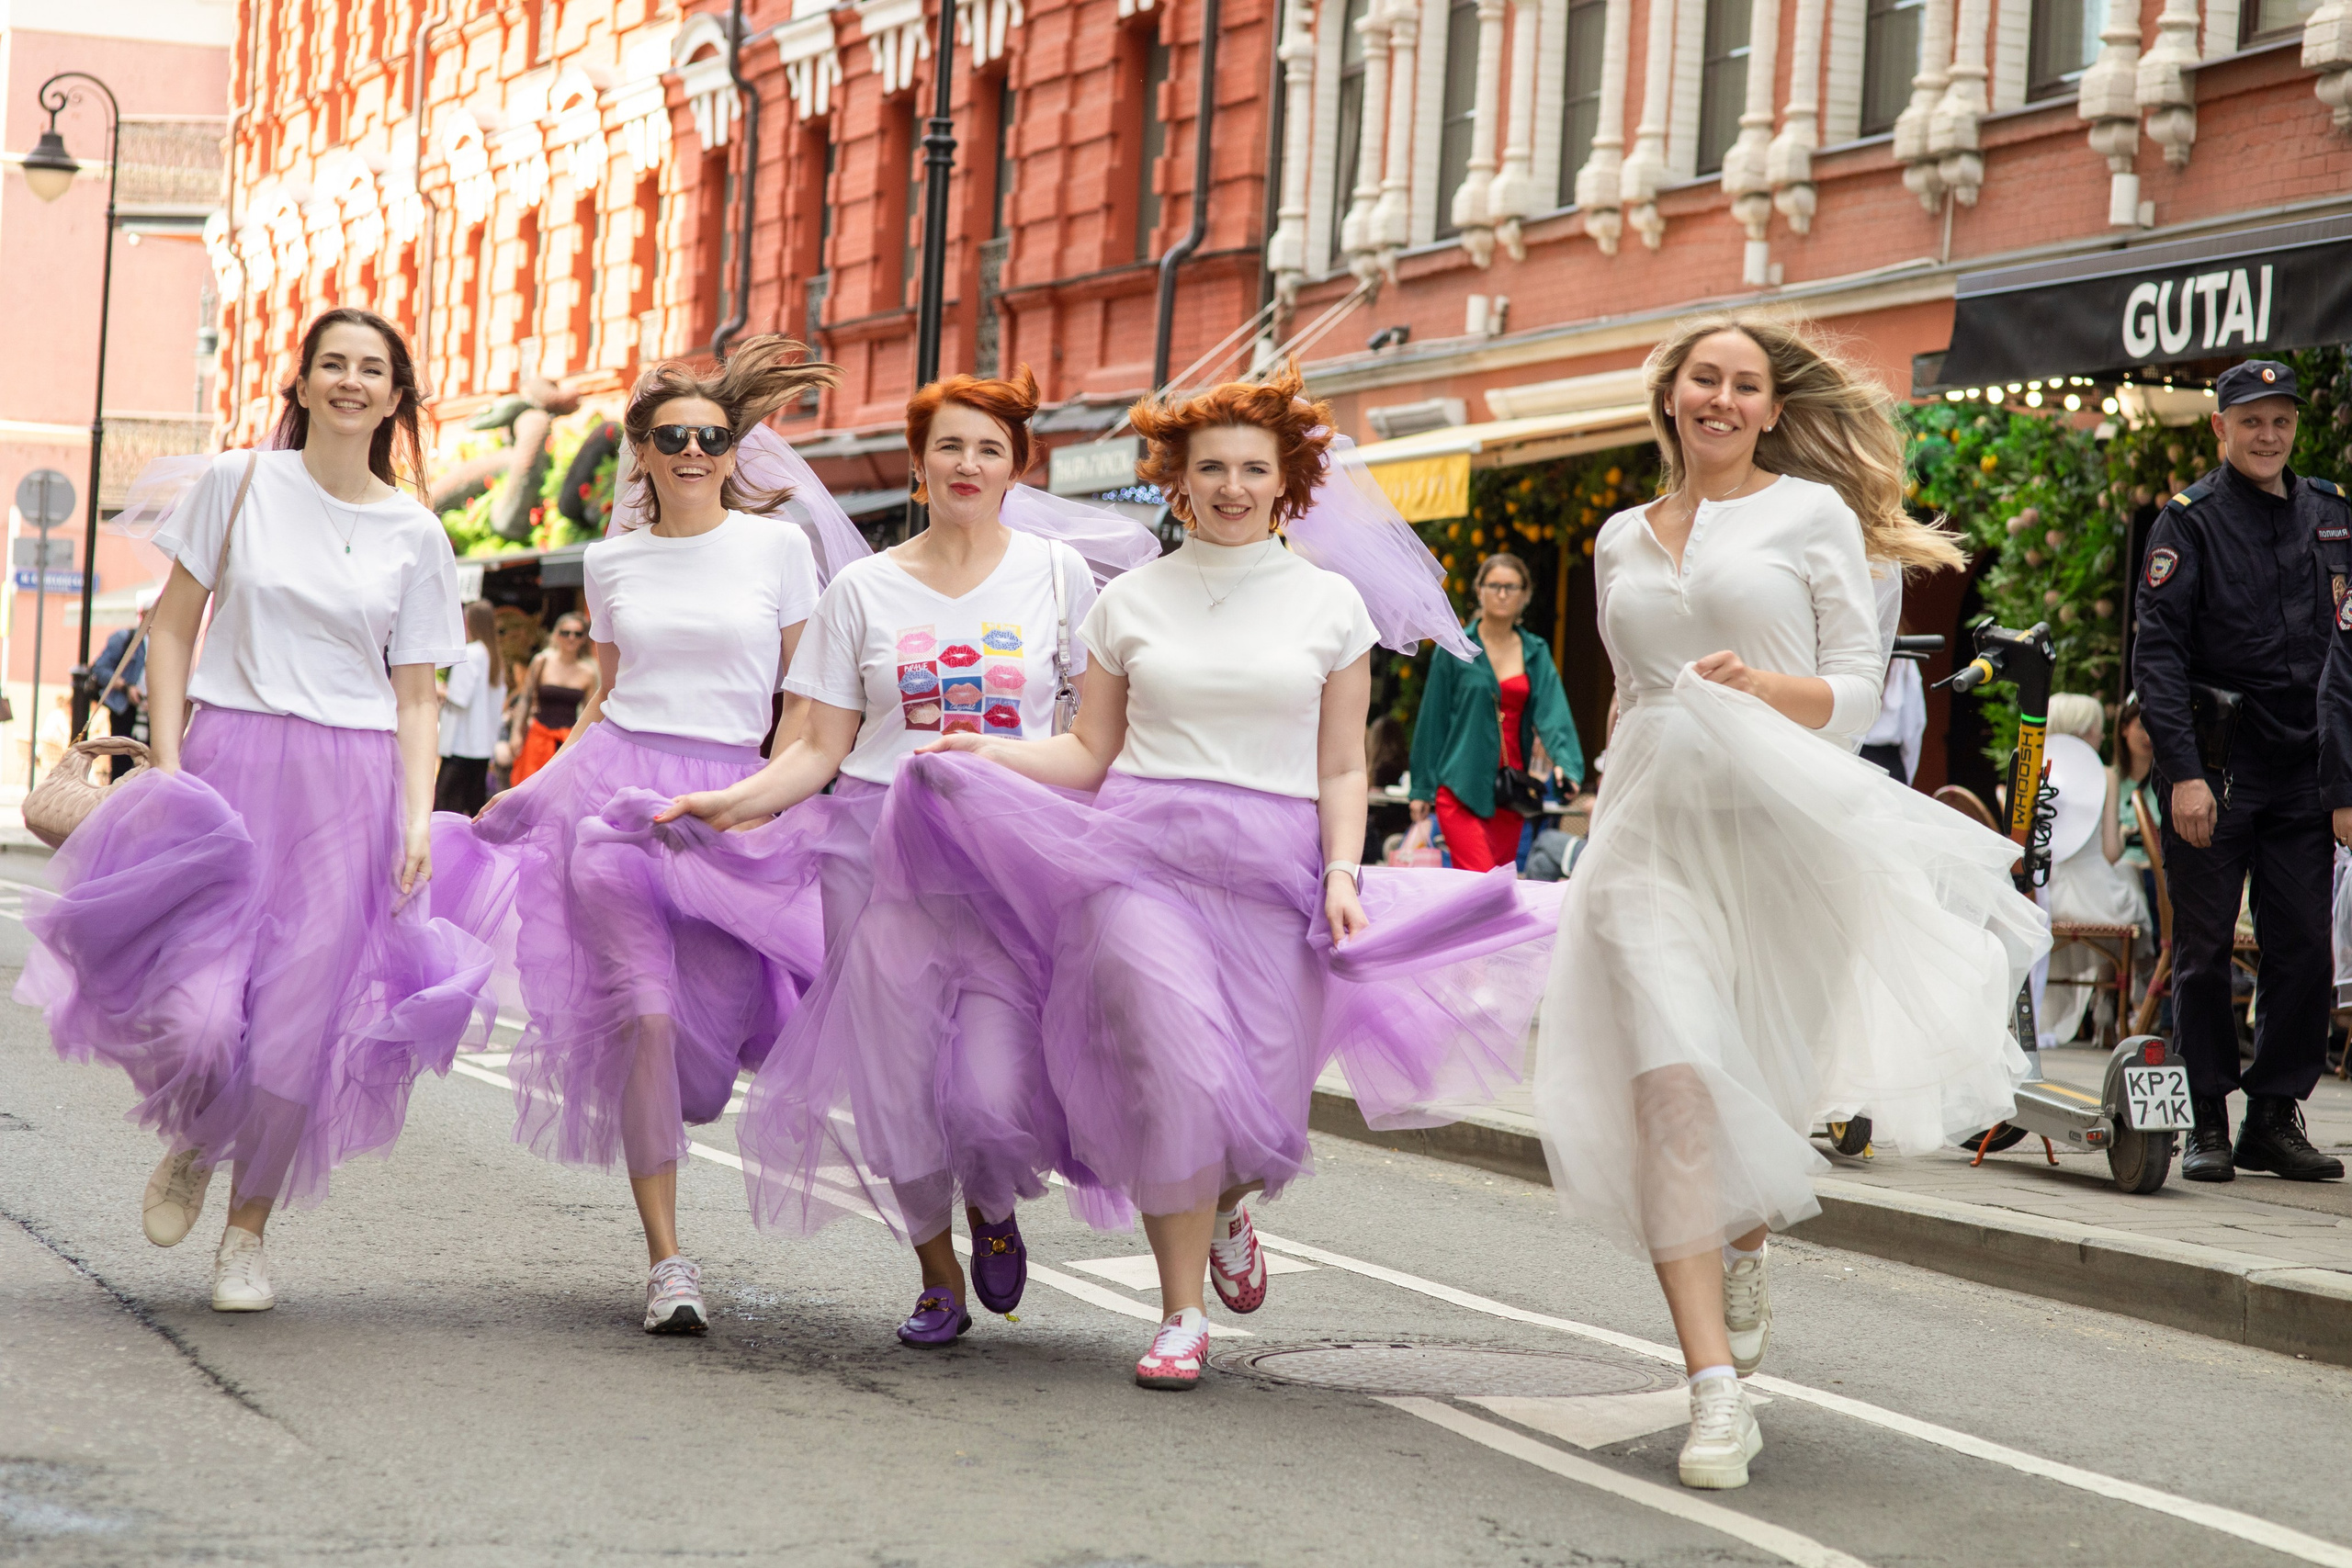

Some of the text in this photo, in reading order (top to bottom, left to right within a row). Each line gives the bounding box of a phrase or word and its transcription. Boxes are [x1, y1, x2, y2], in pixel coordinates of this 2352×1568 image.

[2122, 264, 2273, 358] GUTAI
[2318, 528, 2348, 538] ПОЛИЦИЯ
[2014, 731, 2033, 825] WHOOSH
[2128, 1071, 2186, 1097] KP2
[2133, 1100, 2190, 1125] 71K
